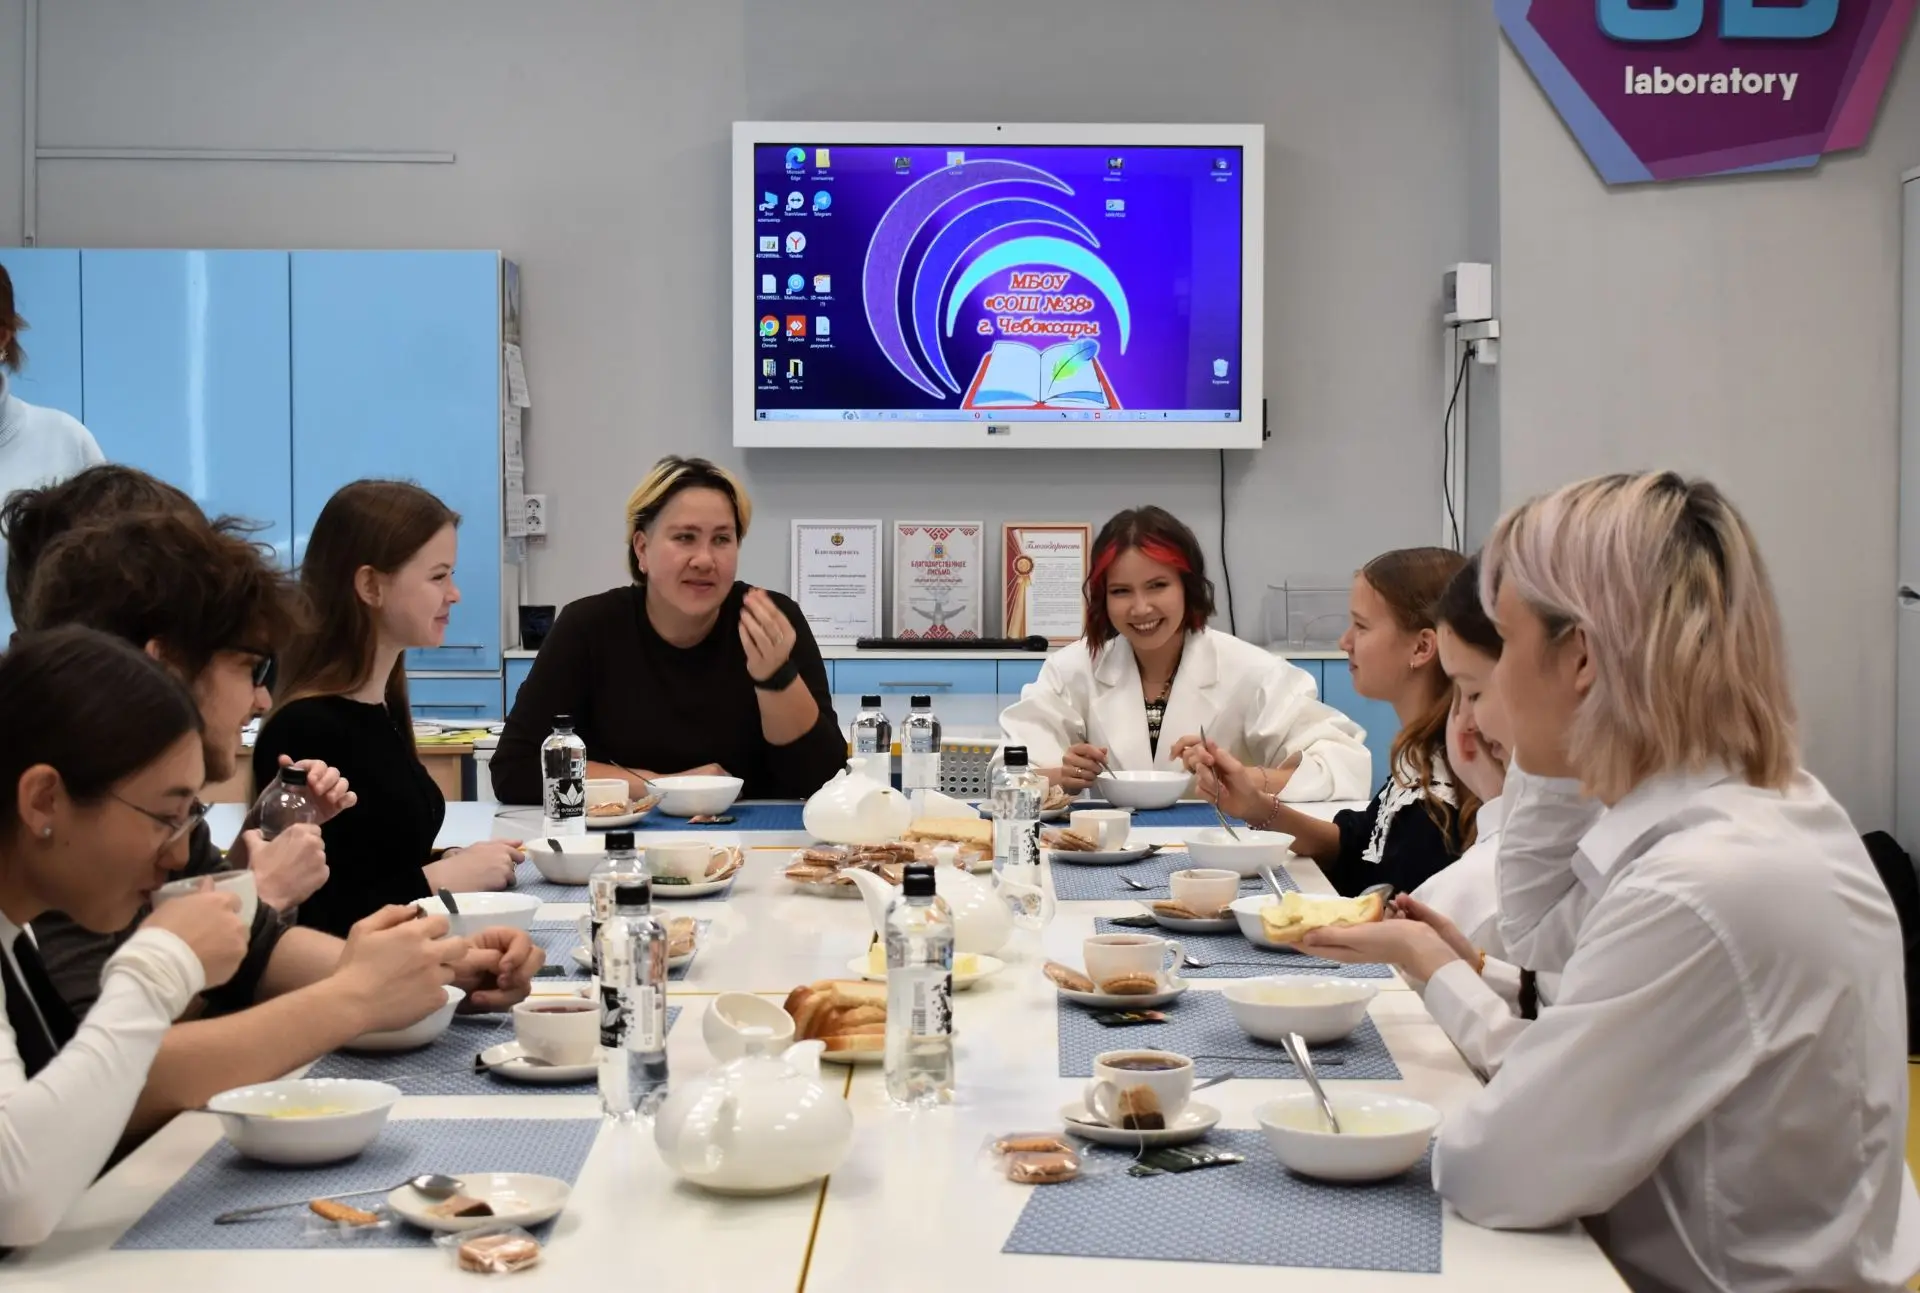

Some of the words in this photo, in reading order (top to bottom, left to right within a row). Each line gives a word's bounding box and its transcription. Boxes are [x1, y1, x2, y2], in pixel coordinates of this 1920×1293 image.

[1624, 65, 1799, 101] laboratory
[1010, 273, 1070, 291] МБОУ
[978, 320, 993, 334] г.
[998, 317, 1099, 339] Чебоксары
[911, 560, 967, 568] БЛАГОДАРСТВЕННОЕ
